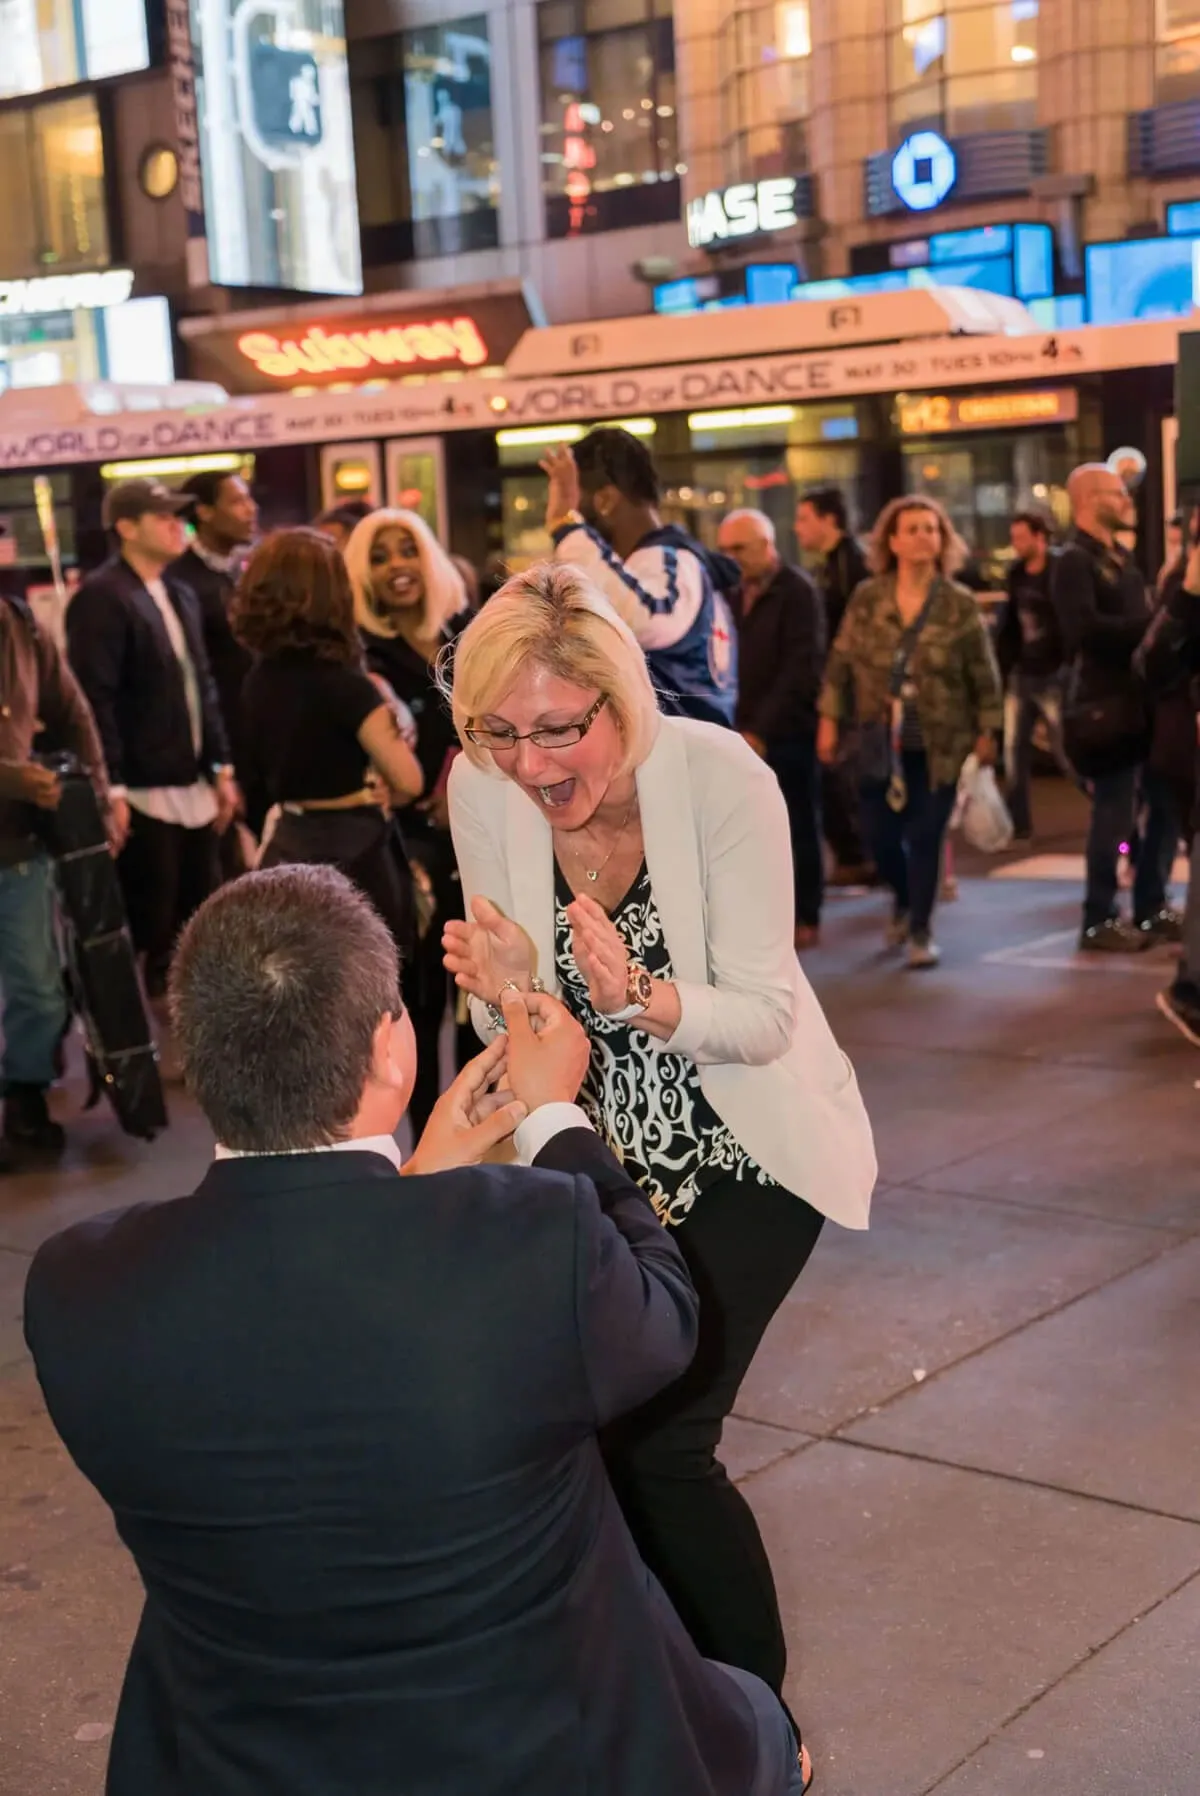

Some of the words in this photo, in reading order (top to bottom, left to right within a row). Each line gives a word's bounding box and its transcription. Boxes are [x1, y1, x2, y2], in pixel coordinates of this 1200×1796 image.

[165, 0, 203, 212] SKECHE
[238, 316, 488, 377] Subway
[485, 380, 641, 415] WORLD
[680, 361, 832, 401] DANCE
[1, 427, 121, 460] WORLD
[153, 414, 275, 447] DANCE
